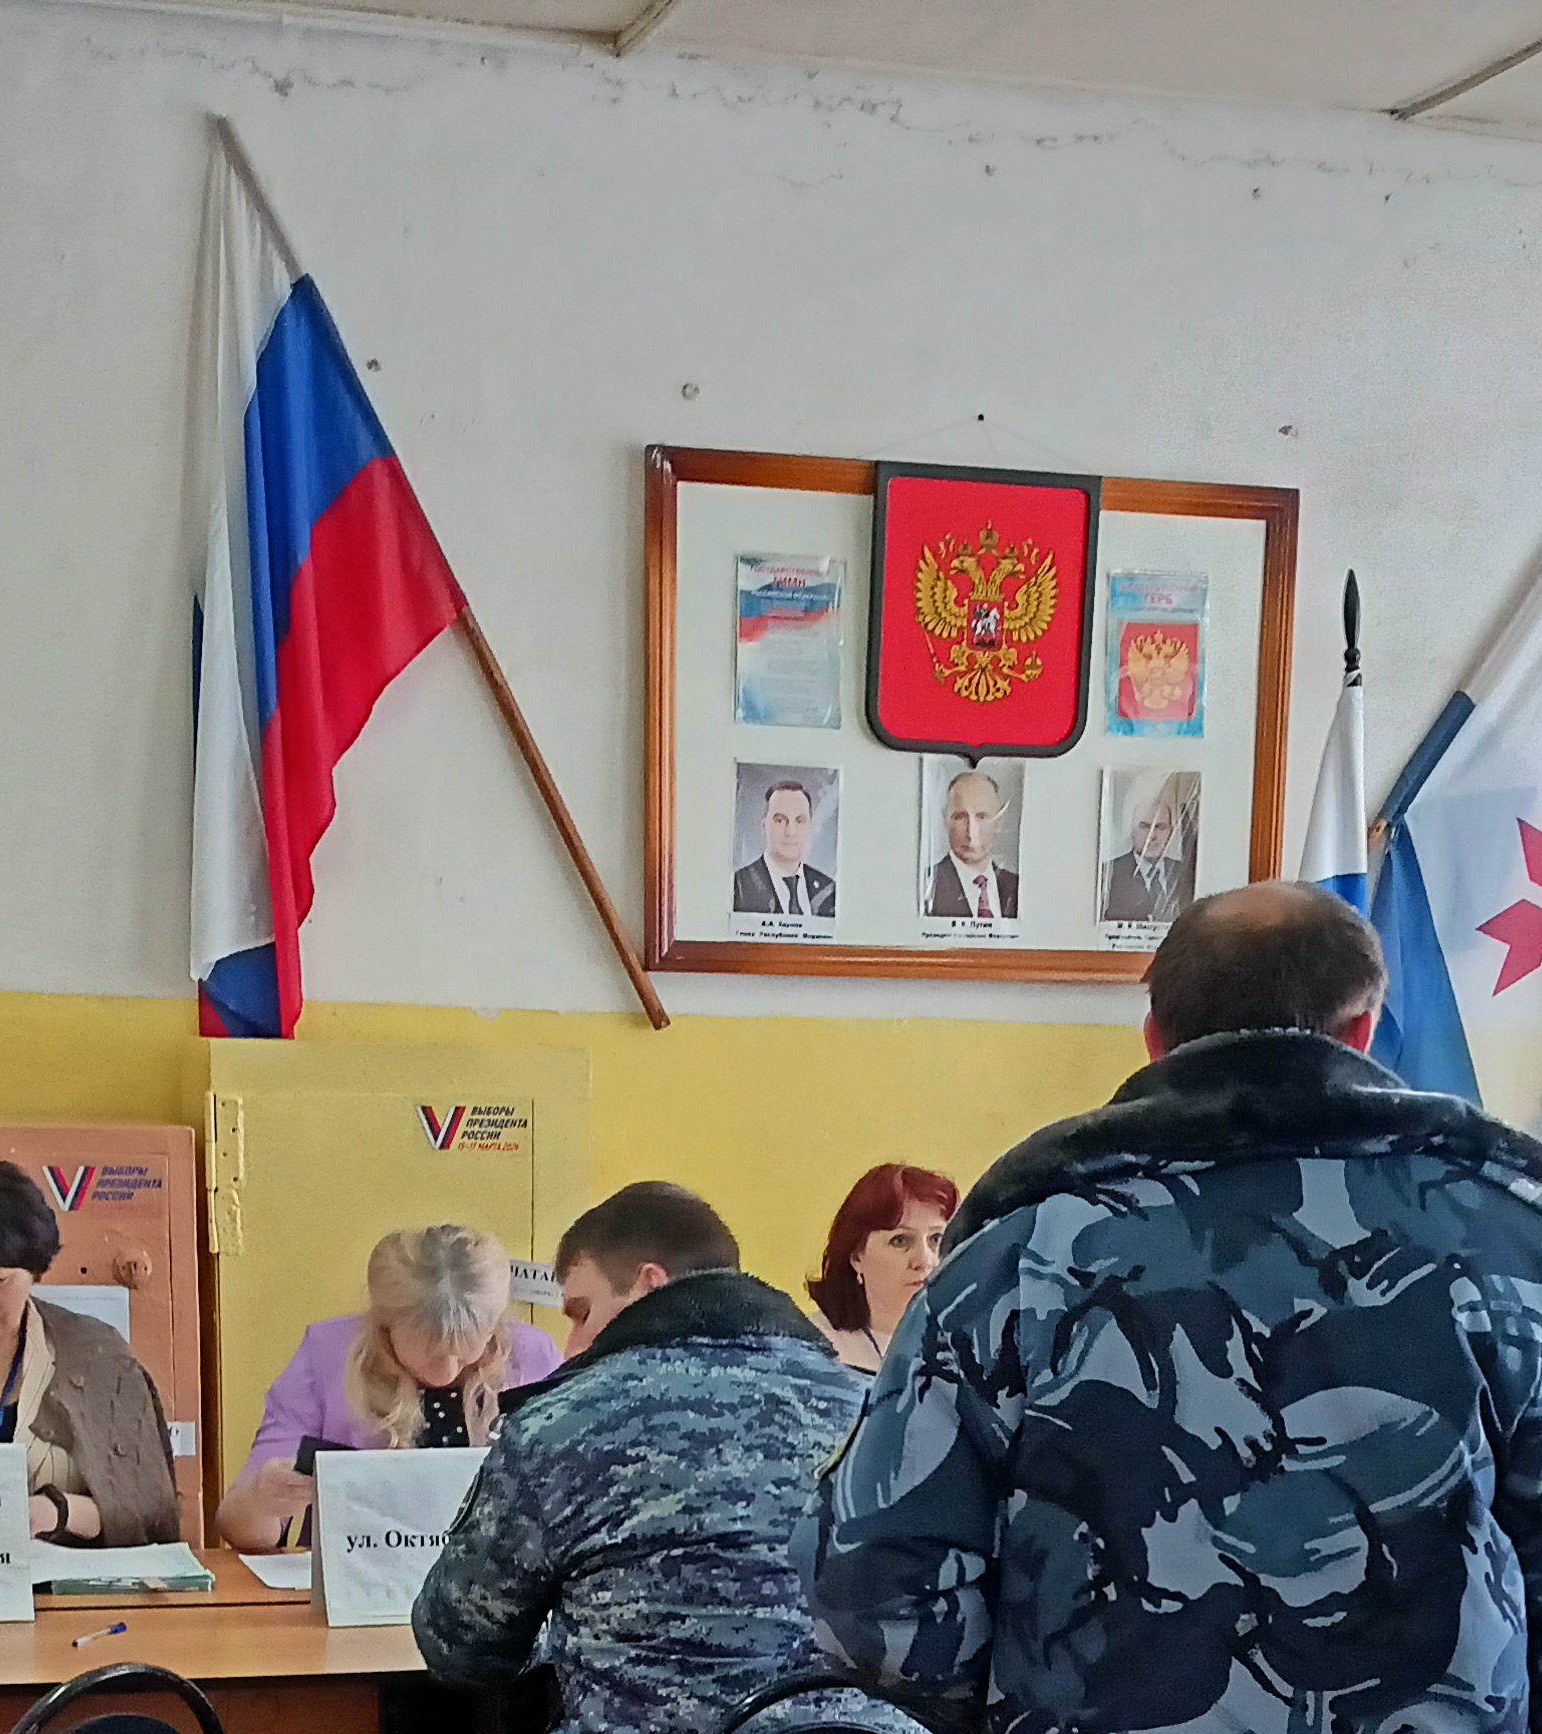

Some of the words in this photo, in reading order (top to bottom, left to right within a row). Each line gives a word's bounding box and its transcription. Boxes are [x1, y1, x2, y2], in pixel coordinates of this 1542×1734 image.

[1144, 593, 1173, 605] ГЕРБ
[471, 1106, 515, 1117] ВЫБОРЫ
[466, 1118, 528, 1130] ПРЕЗИДЕНТА
[461, 1130, 502, 1141] РОССИИ
[102, 1165, 148, 1176] ВЫБОРЫ
[96, 1178, 163, 1189] ПРЕЗИДЕНТА
[91, 1191, 135, 1201] РОССИИ
[346, 1535, 378, 1552] ул.
